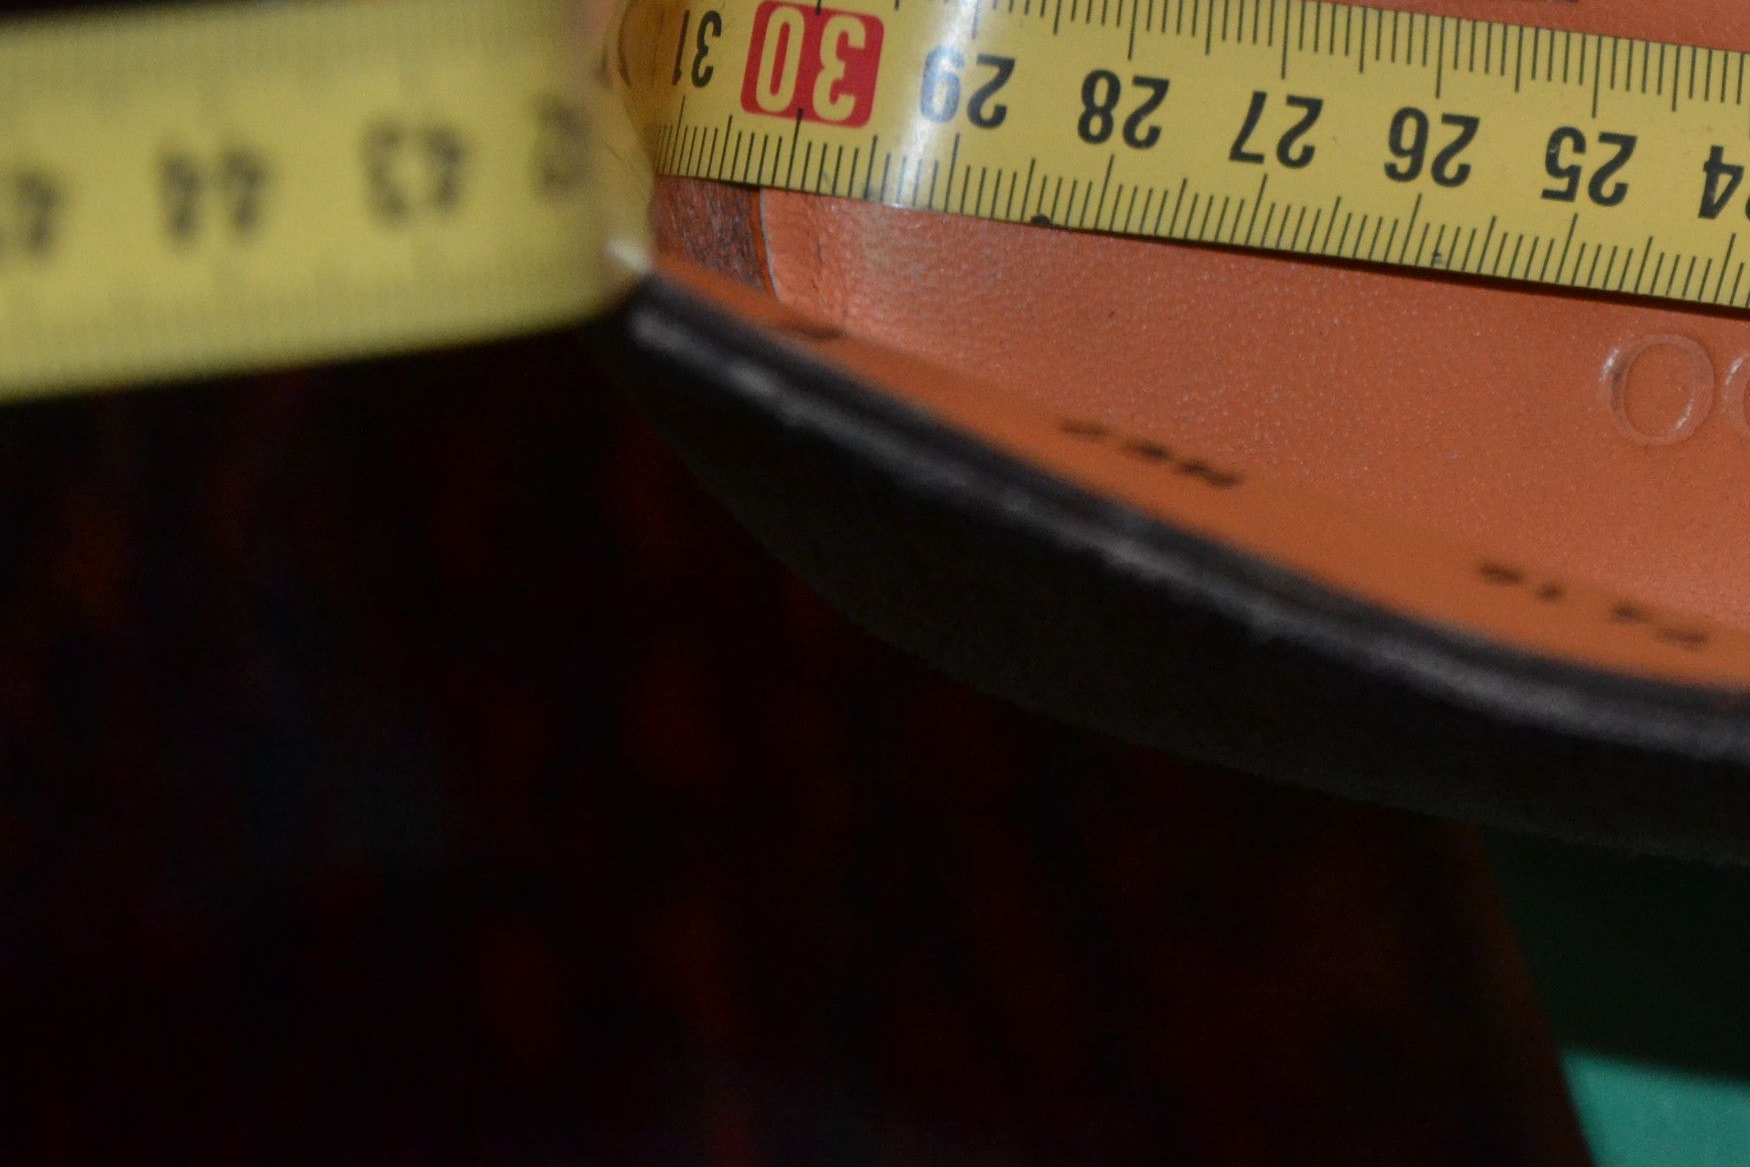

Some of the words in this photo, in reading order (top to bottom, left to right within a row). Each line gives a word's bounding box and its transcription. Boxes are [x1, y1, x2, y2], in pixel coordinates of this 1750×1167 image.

[672, 9, 722, 88] 31
[754, 5, 867, 122] 30
[919, 44, 1017, 128] 29
[1077, 69, 1170, 150] 28
[1228, 90, 1325, 169] 27
[1384, 106, 1480, 188] 26
[1540, 126, 1639, 207] 25
